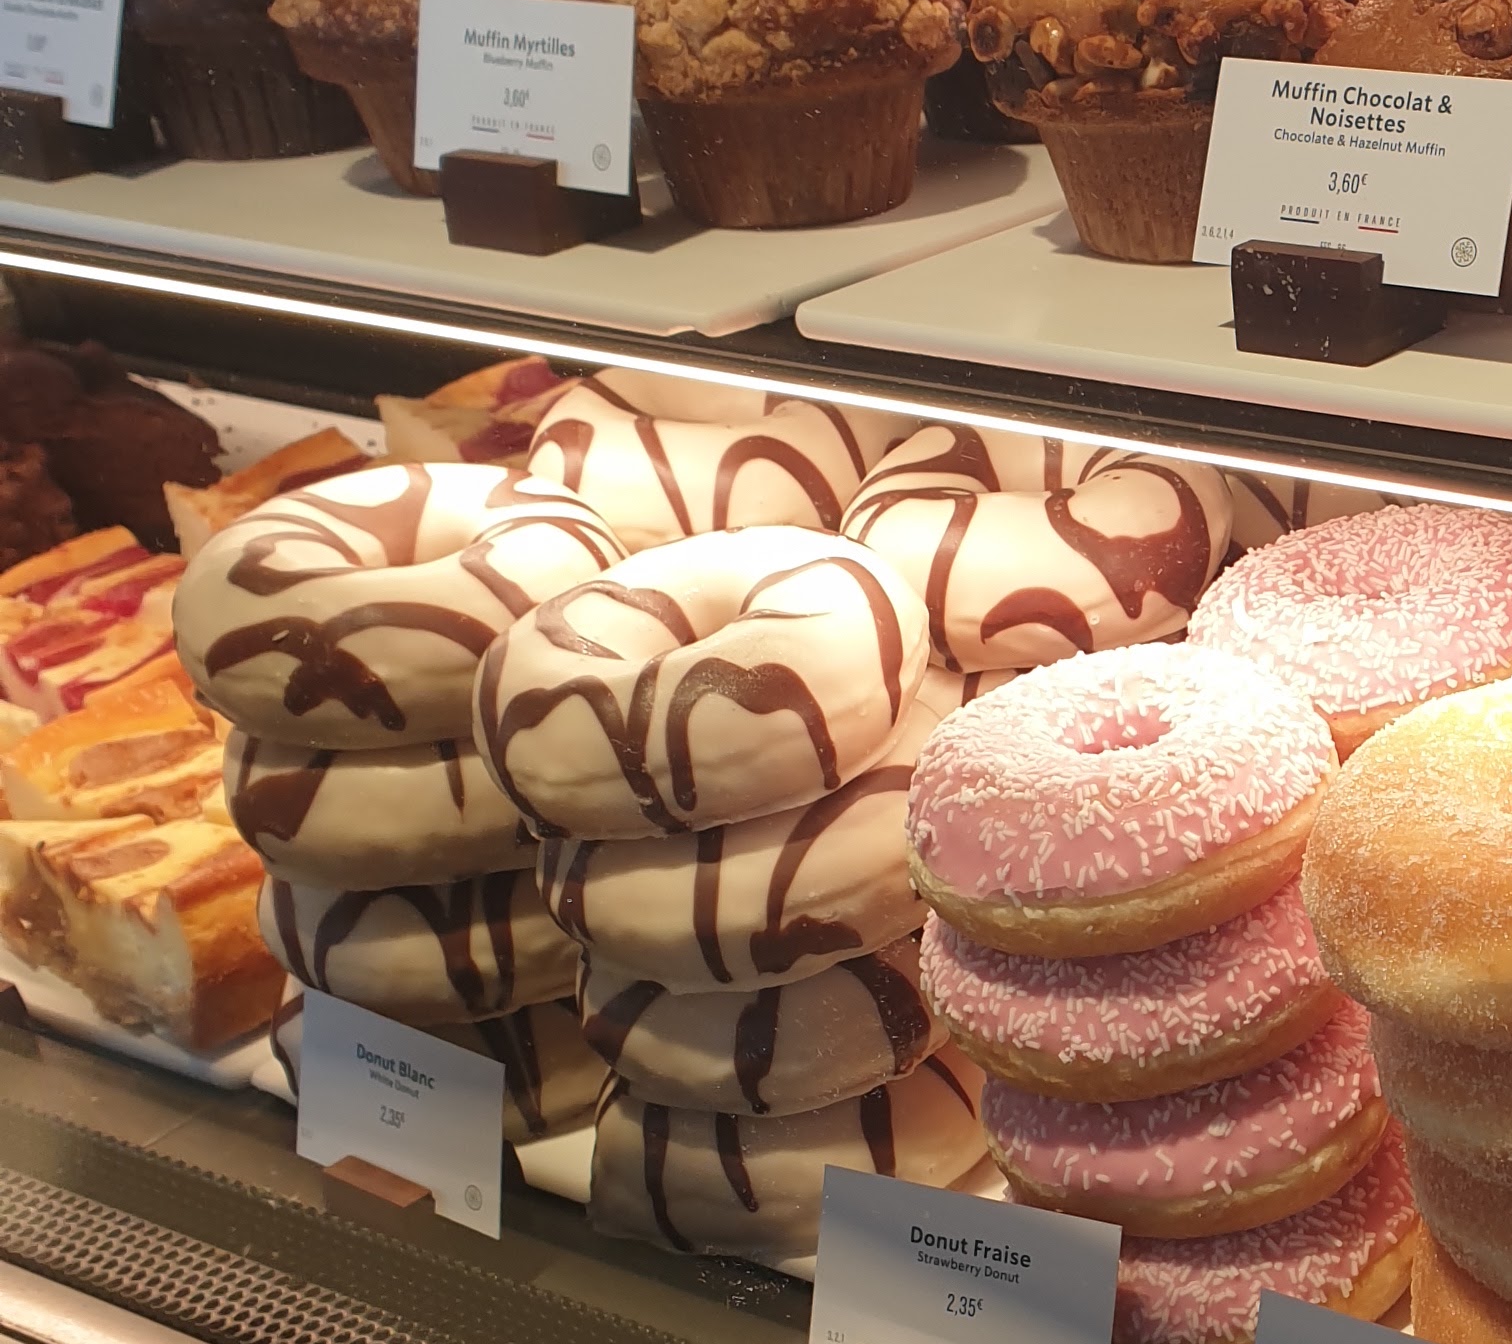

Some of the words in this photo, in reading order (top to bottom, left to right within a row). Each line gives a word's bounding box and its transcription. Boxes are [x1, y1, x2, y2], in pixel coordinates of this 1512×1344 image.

[464, 28, 509, 50] Muffin
[514, 34, 576, 57] Myrtilles
[1272, 80, 1336, 104] Muffin
[1344, 86, 1432, 113] Chocolat
[1438, 94, 1452, 114] &
[1310, 107, 1406, 134] Noisettes
[1274, 128, 1334, 146] Chocolate
[1338, 135, 1345, 147] &
[1350, 135, 1402, 153] Hazelnut
[1406, 142, 1446, 156] Muffin
[1328, 172, 1368, 196] 3,60€
[1281, 204, 1330, 220] PRODUIT
[1337, 210, 1350, 222] EN
[1358, 214, 1400, 228] FRANCE
[356, 1043, 396, 1074] Donut
[398, 1061, 436, 1090] Blanc
[910, 1226, 968, 1256] Donut
[974, 1240, 1032, 1268] Fraise
[918, 1251, 982, 1277] Strawberry
[984, 1266, 1020, 1284] Donut
[946, 1293, 984, 1317] 2,35€
